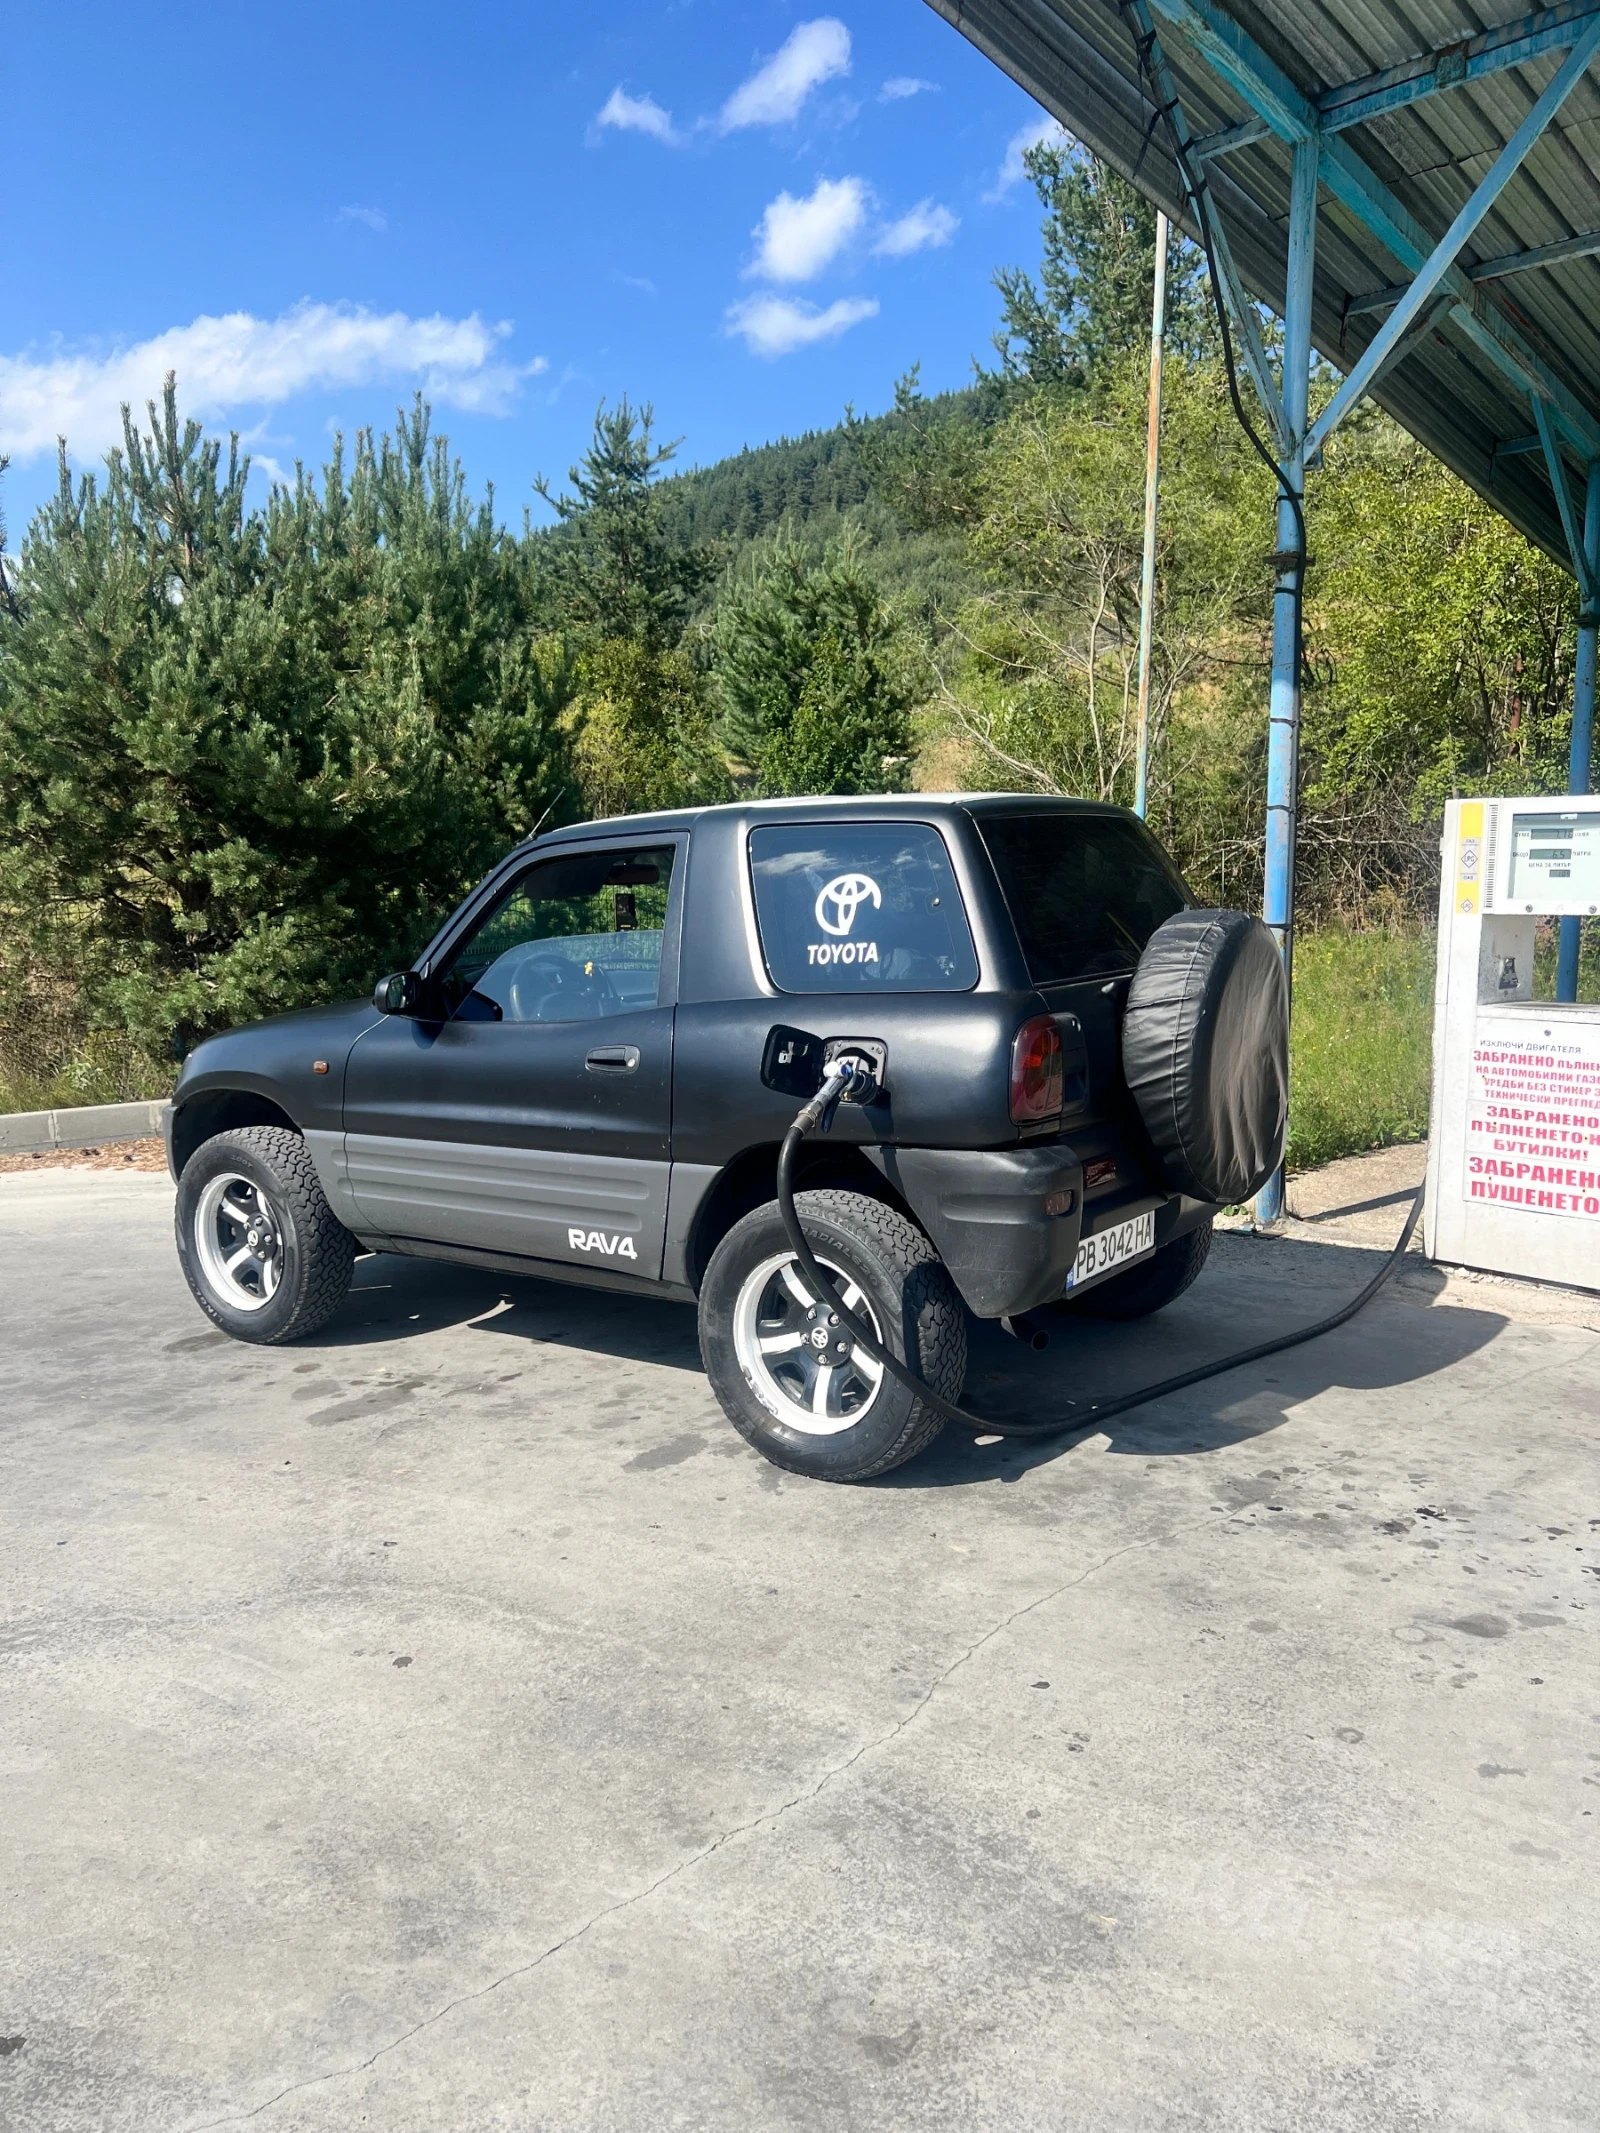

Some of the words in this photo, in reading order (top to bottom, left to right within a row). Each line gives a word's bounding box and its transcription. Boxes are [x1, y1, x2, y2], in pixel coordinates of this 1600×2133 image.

[807, 942, 879, 965] TOYOTA
[1480, 1039, 1524, 1049] ИЗКЛЮЧИ
[1526, 1042, 1581, 1054] ДВИГАТЕЛЯ
[1473, 1050, 1554, 1067] ЗАБРАНЕНО
[1476, 1065, 1489, 1074] НА
[1491, 1067, 1573, 1082] АВТОМОБИЛНИ
[1484, 1078, 1524, 1089] УРЕДБИ
[1527, 1082, 1546, 1091] БЕЗ
[1550, 1084, 1591, 1095] СТИКЕР
[1485, 1089, 1551, 1104] ТЕХНИЧЕСКИ
[1486, 1105, 1599, 1128] ЗАБРАНЕНО
[1471, 1120, 1583, 1143] ПЪЛНЕНЕТО
[1494, 1139, 1588, 1161] БУТИЛКИ!
[1469, 1157, 1600, 1190] ЗАБРАНЕН
[1471, 1180, 1599, 1214] ПУШЕНЕТО
[568, 1228, 638, 1260] RAV4
[1077, 1241, 1095, 1278] PB
[1099, 1223, 1133, 1266] 3042
[1135, 1214, 1152, 1249] HA
